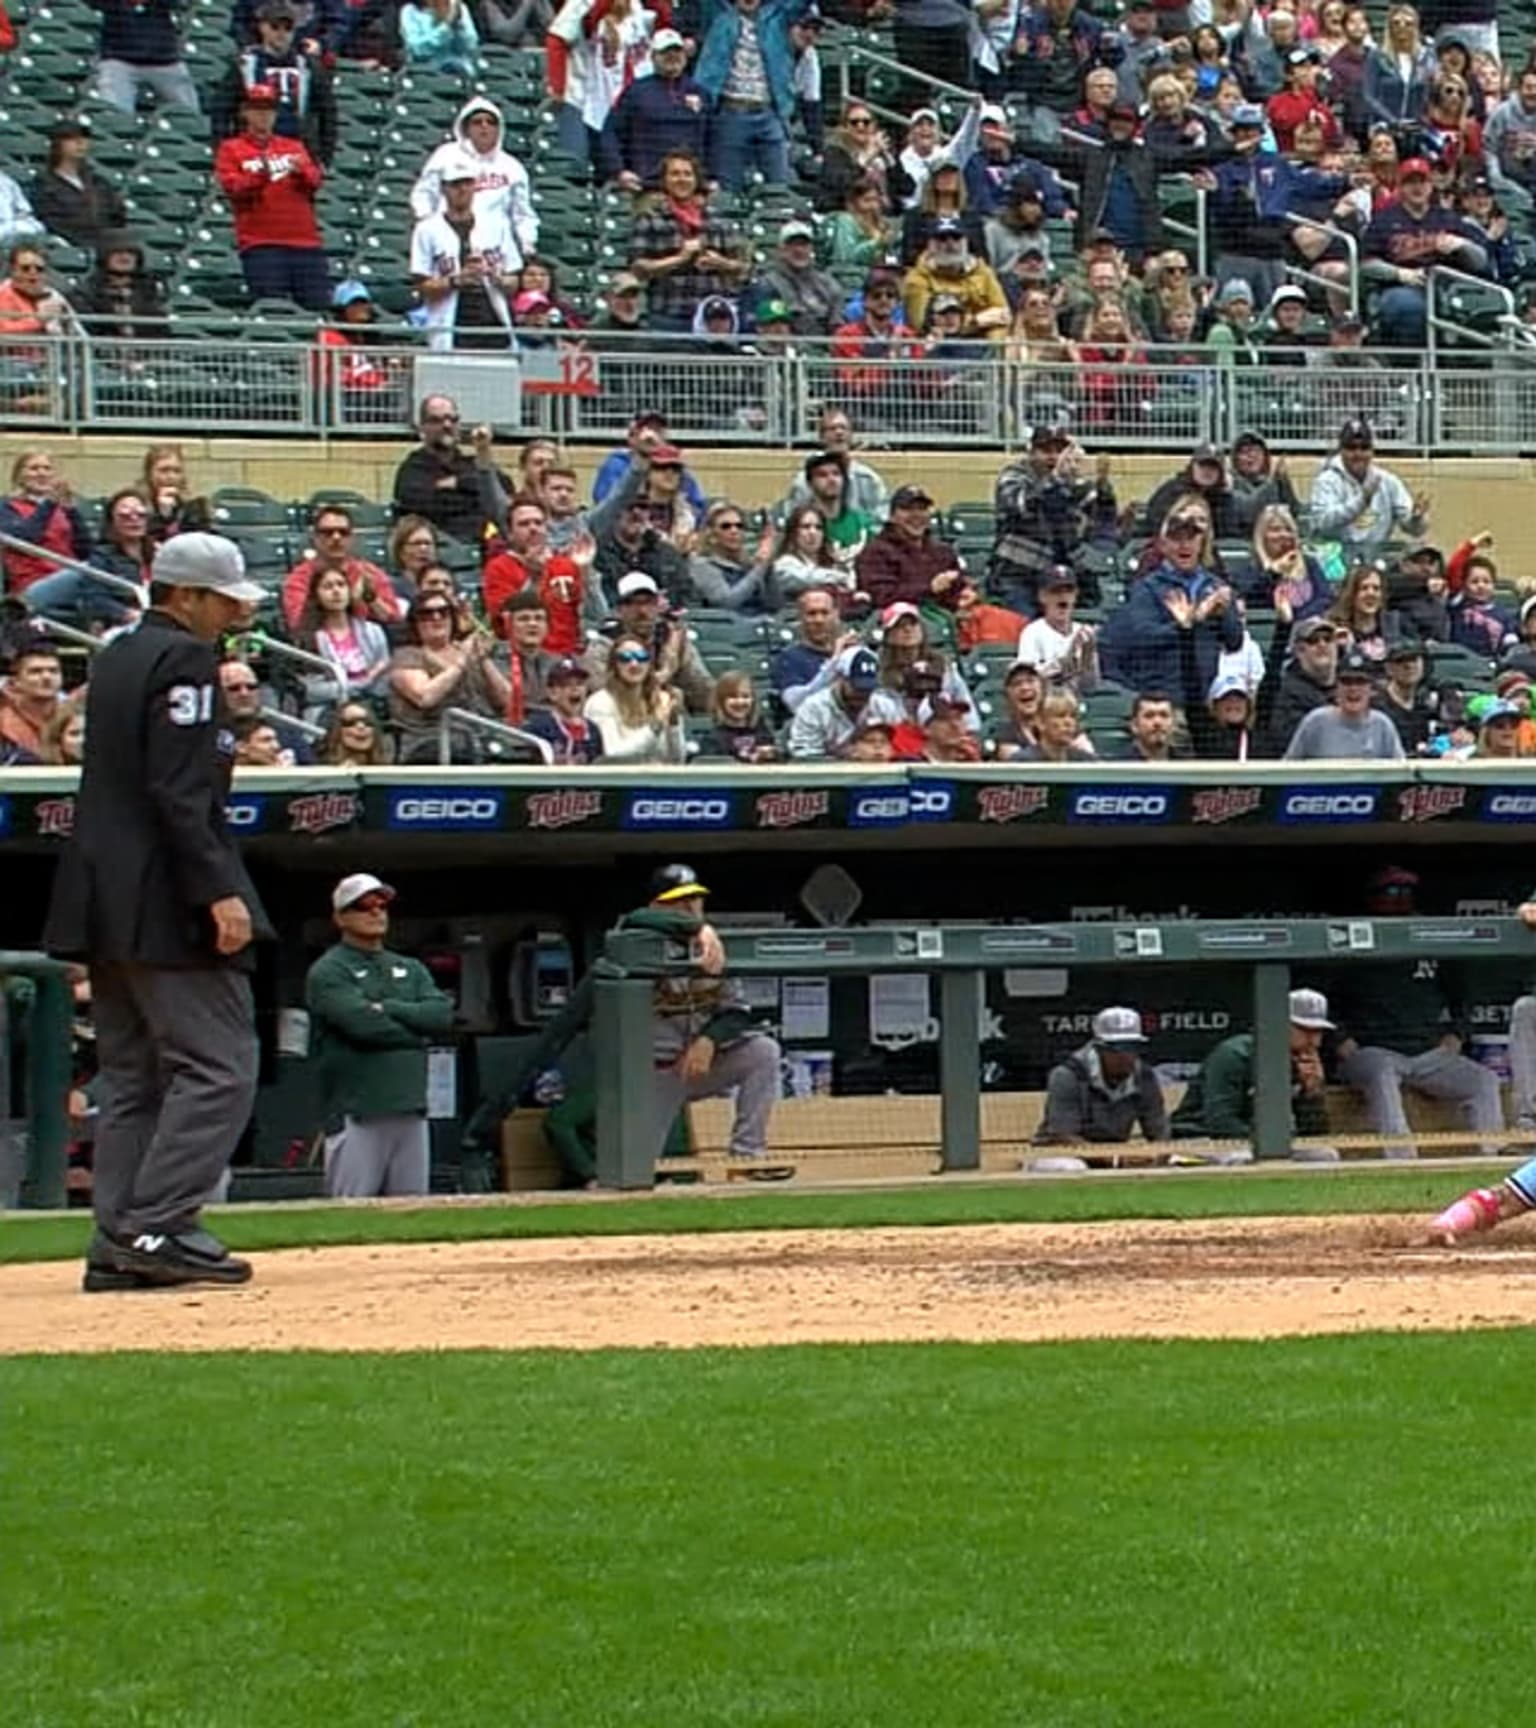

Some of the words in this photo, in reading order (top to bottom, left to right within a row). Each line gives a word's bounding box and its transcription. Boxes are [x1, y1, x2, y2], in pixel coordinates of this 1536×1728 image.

[559, 355, 594, 381] 12
[549, 576, 574, 603] T
[168, 684, 214, 726] 31
[287, 794, 358, 833] Twins
[396, 798, 498, 820] GEICO
[526, 789, 603, 830] Twins
[631, 799, 728, 821] GEICO
[756, 789, 830, 829] Twins
[978, 784, 1050, 823] Twins
[1075, 794, 1166, 816] GEICO
[1192, 786, 1262, 824] Twins
[1286, 794, 1375, 815] GEICO
[1398, 785, 1466, 823] Twins
[1160, 1011, 1230, 1031] FIELD
